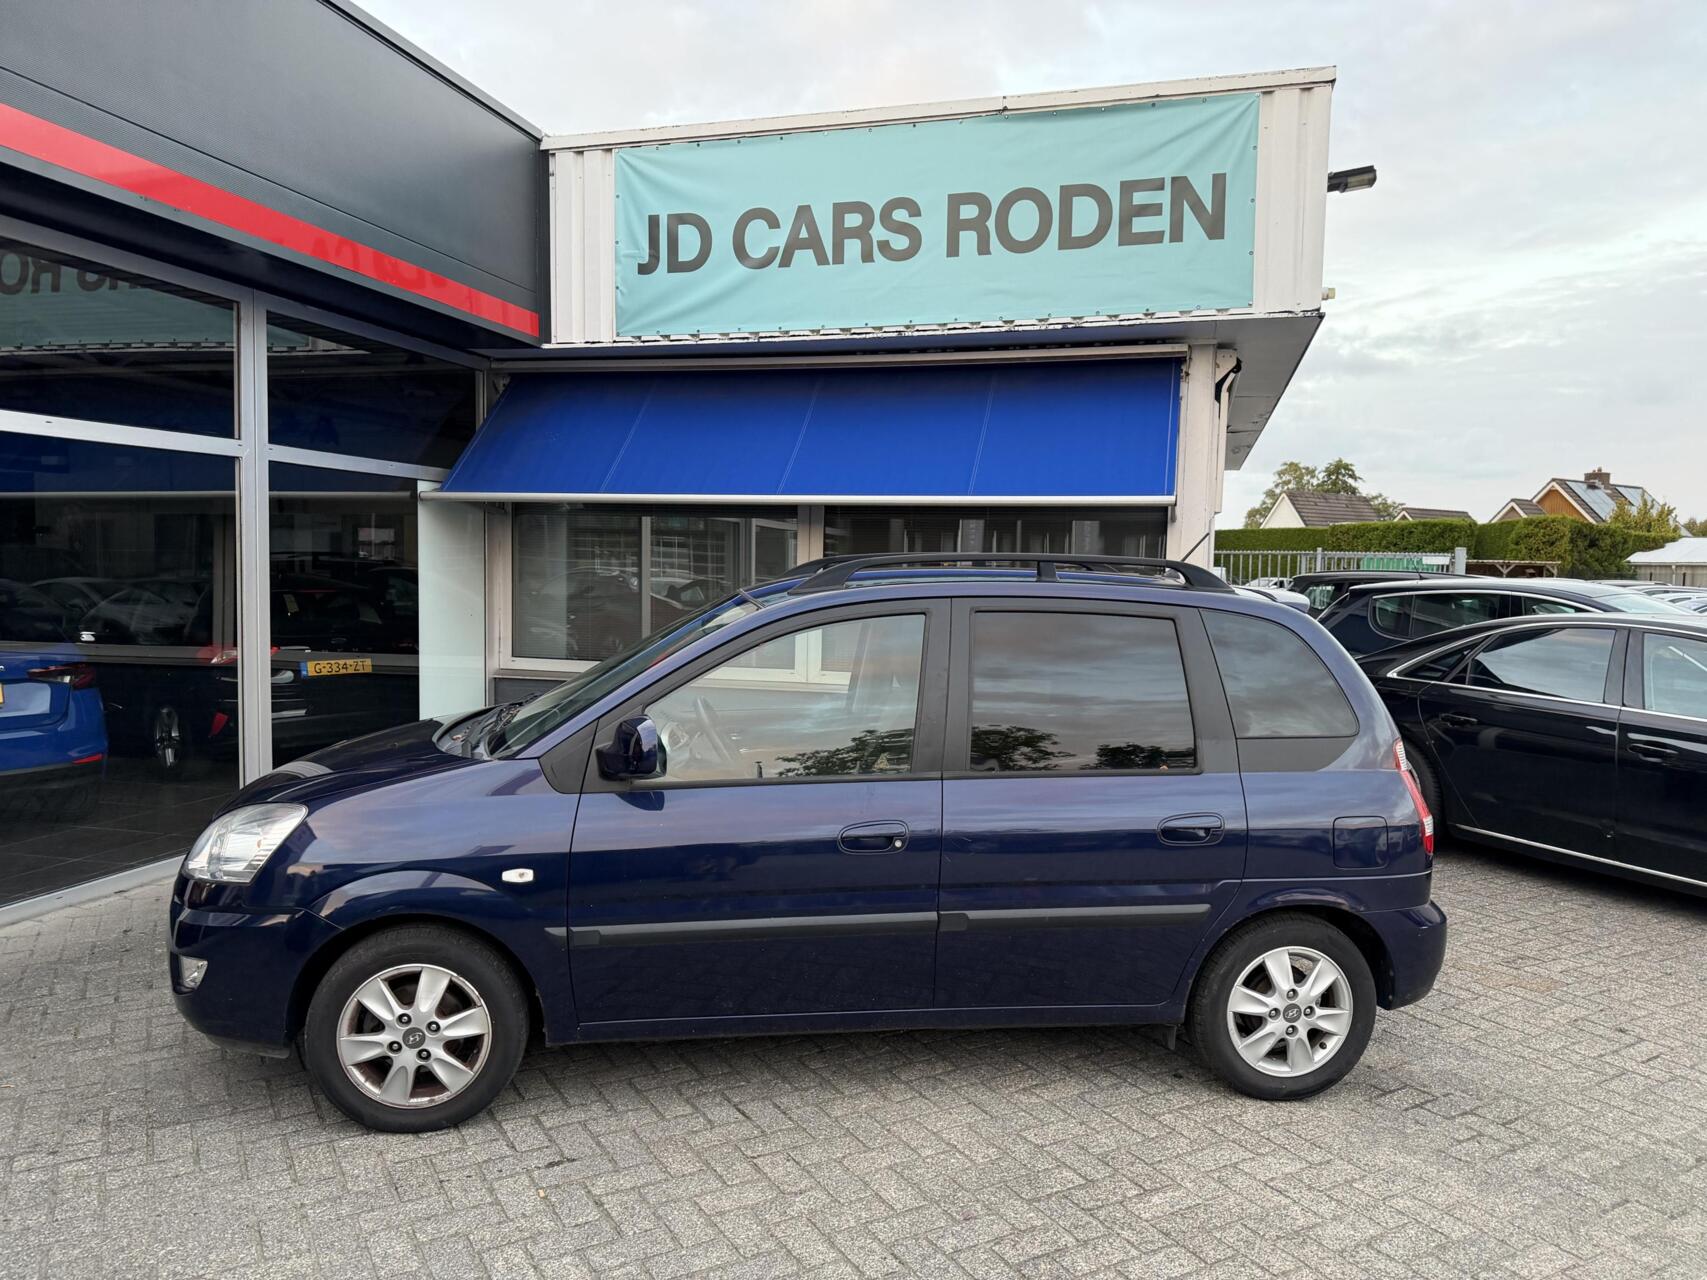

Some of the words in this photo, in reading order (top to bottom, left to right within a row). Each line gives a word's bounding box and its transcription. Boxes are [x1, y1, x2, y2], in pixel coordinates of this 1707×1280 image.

[638, 213, 712, 275] JD
[733, 197, 922, 269] CARS
[947, 173, 1226, 257] RODEN
[313, 660, 367, 674] G-334-ZT
